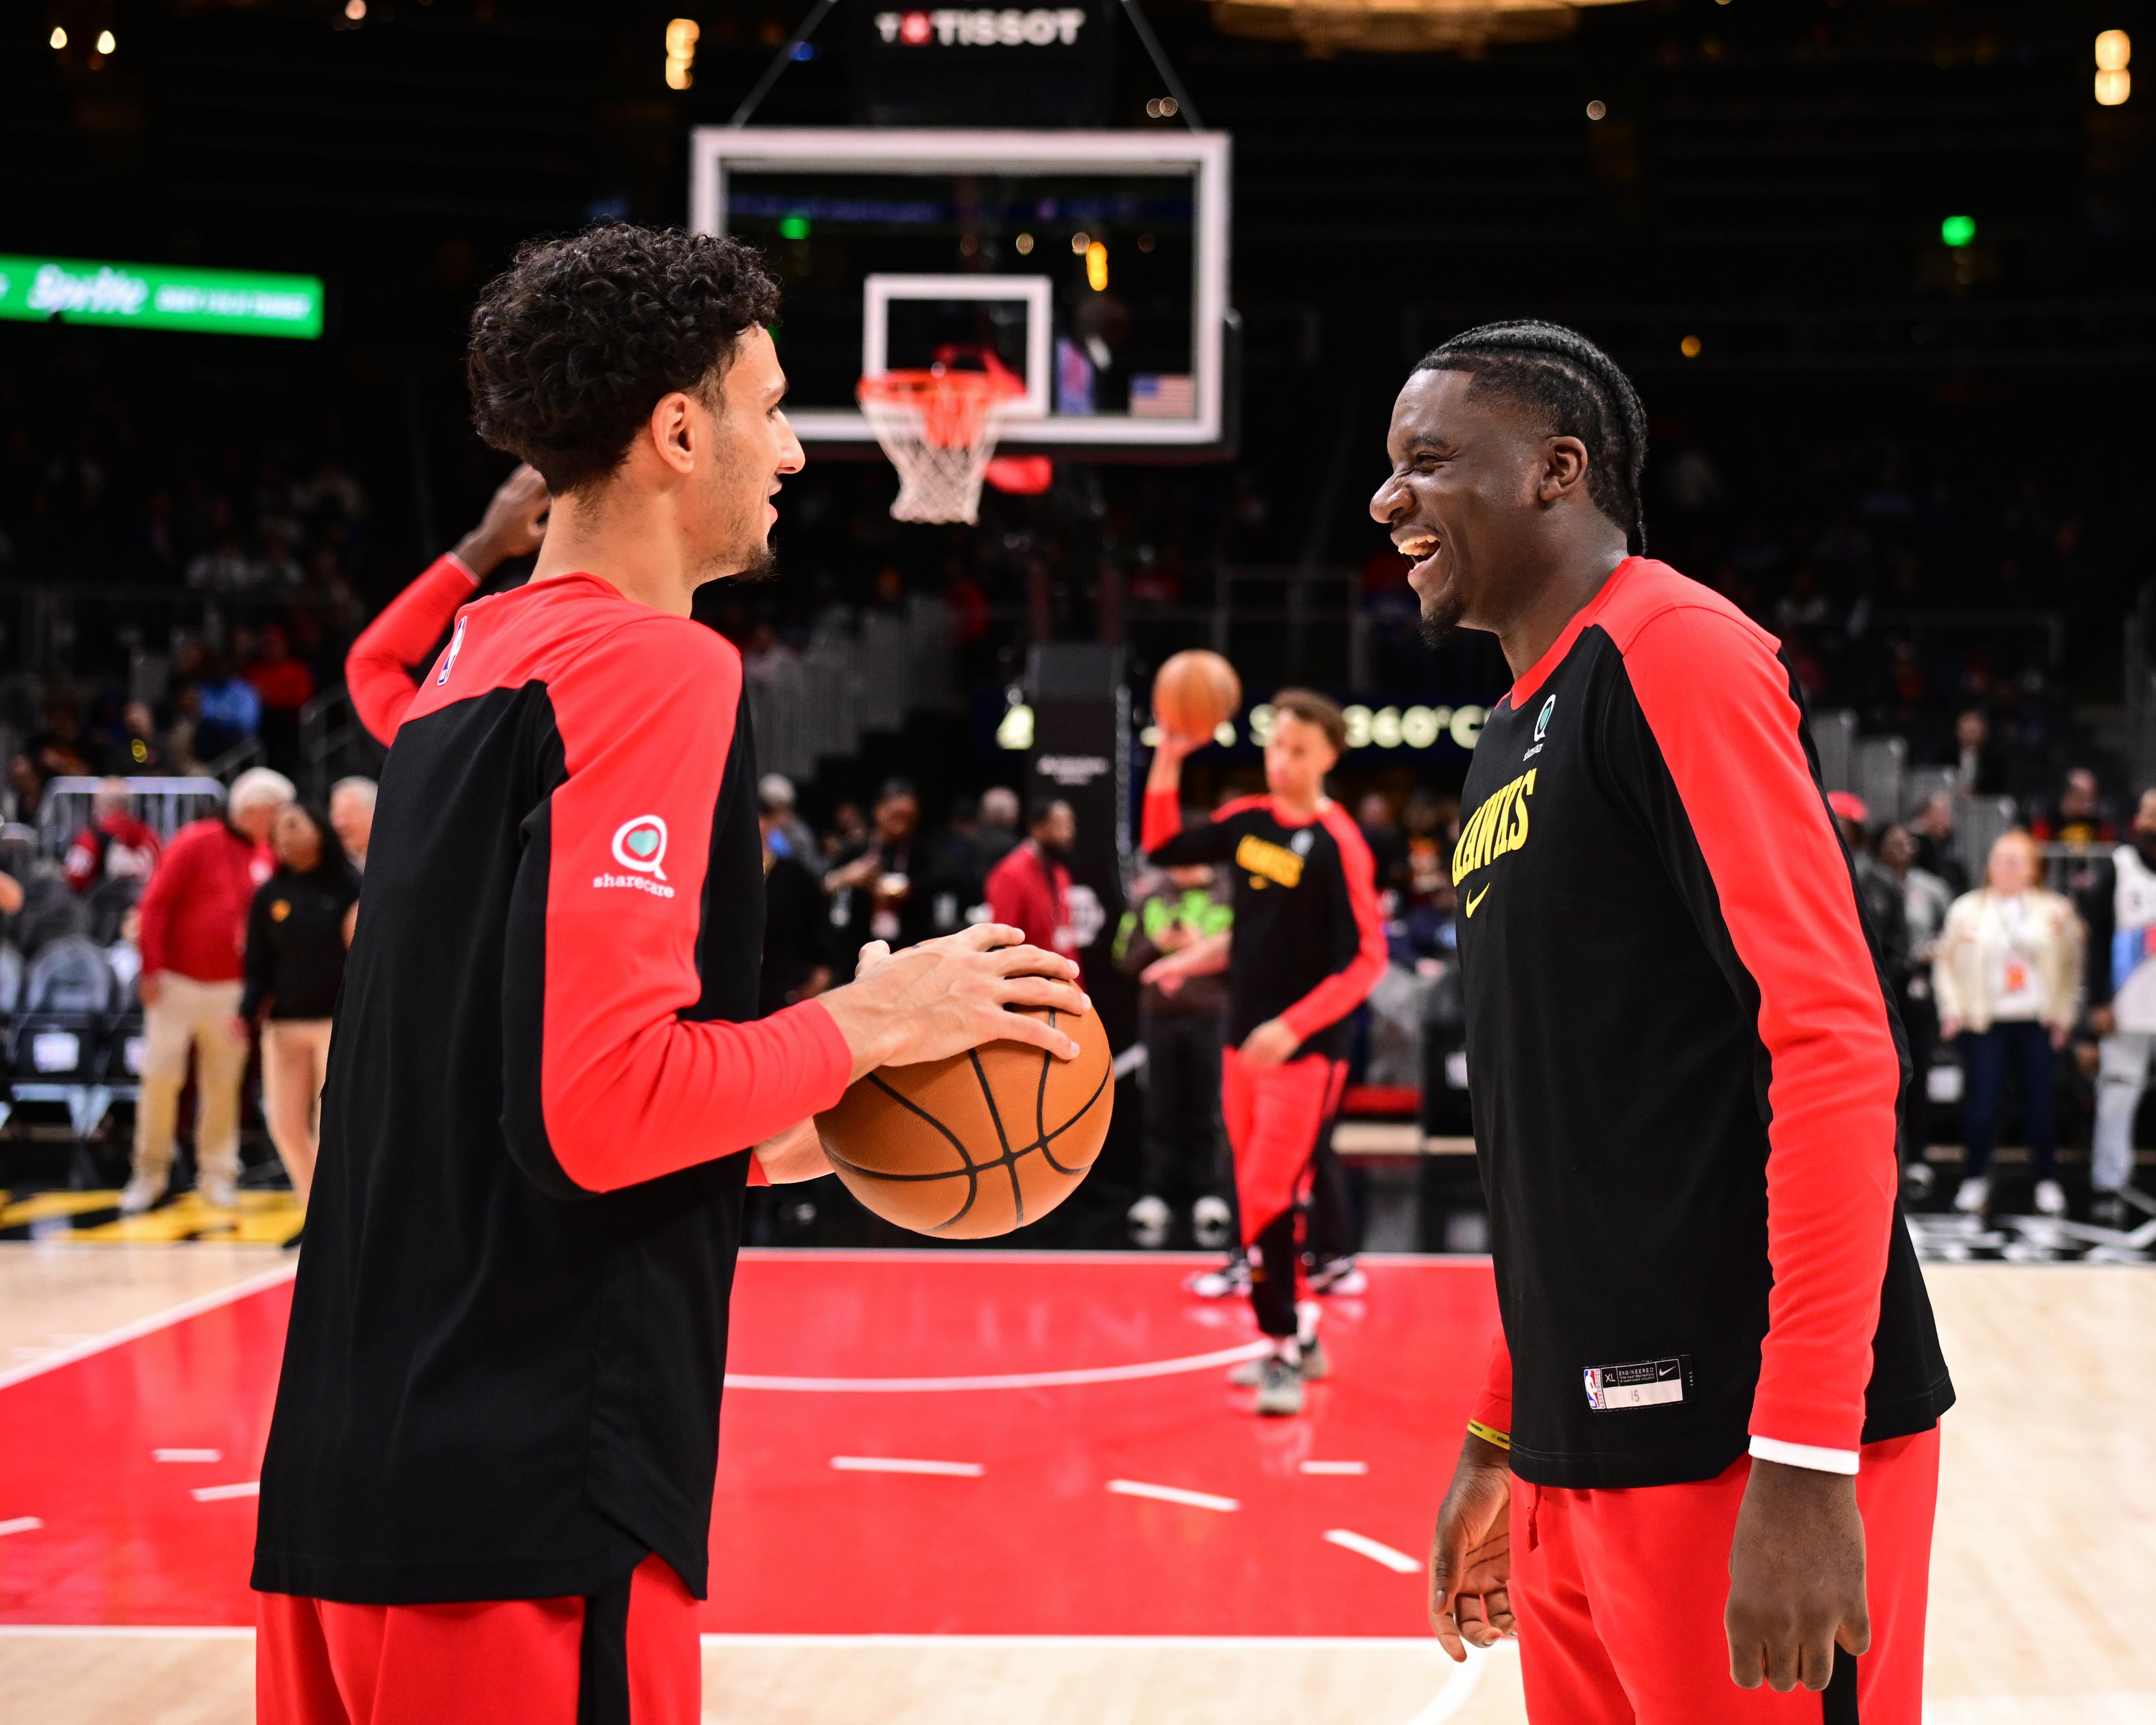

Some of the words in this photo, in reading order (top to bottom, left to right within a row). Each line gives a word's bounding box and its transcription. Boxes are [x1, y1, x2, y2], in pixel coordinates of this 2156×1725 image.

[931, 8, 1087, 46] TISSOT
[1343, 704, 1497, 750] 360°C
[593, 872, 675, 898] sharecare
[1605, 1373, 1616, 1383] XL
[1618, 1367, 1654, 1376] ENGINEERED
